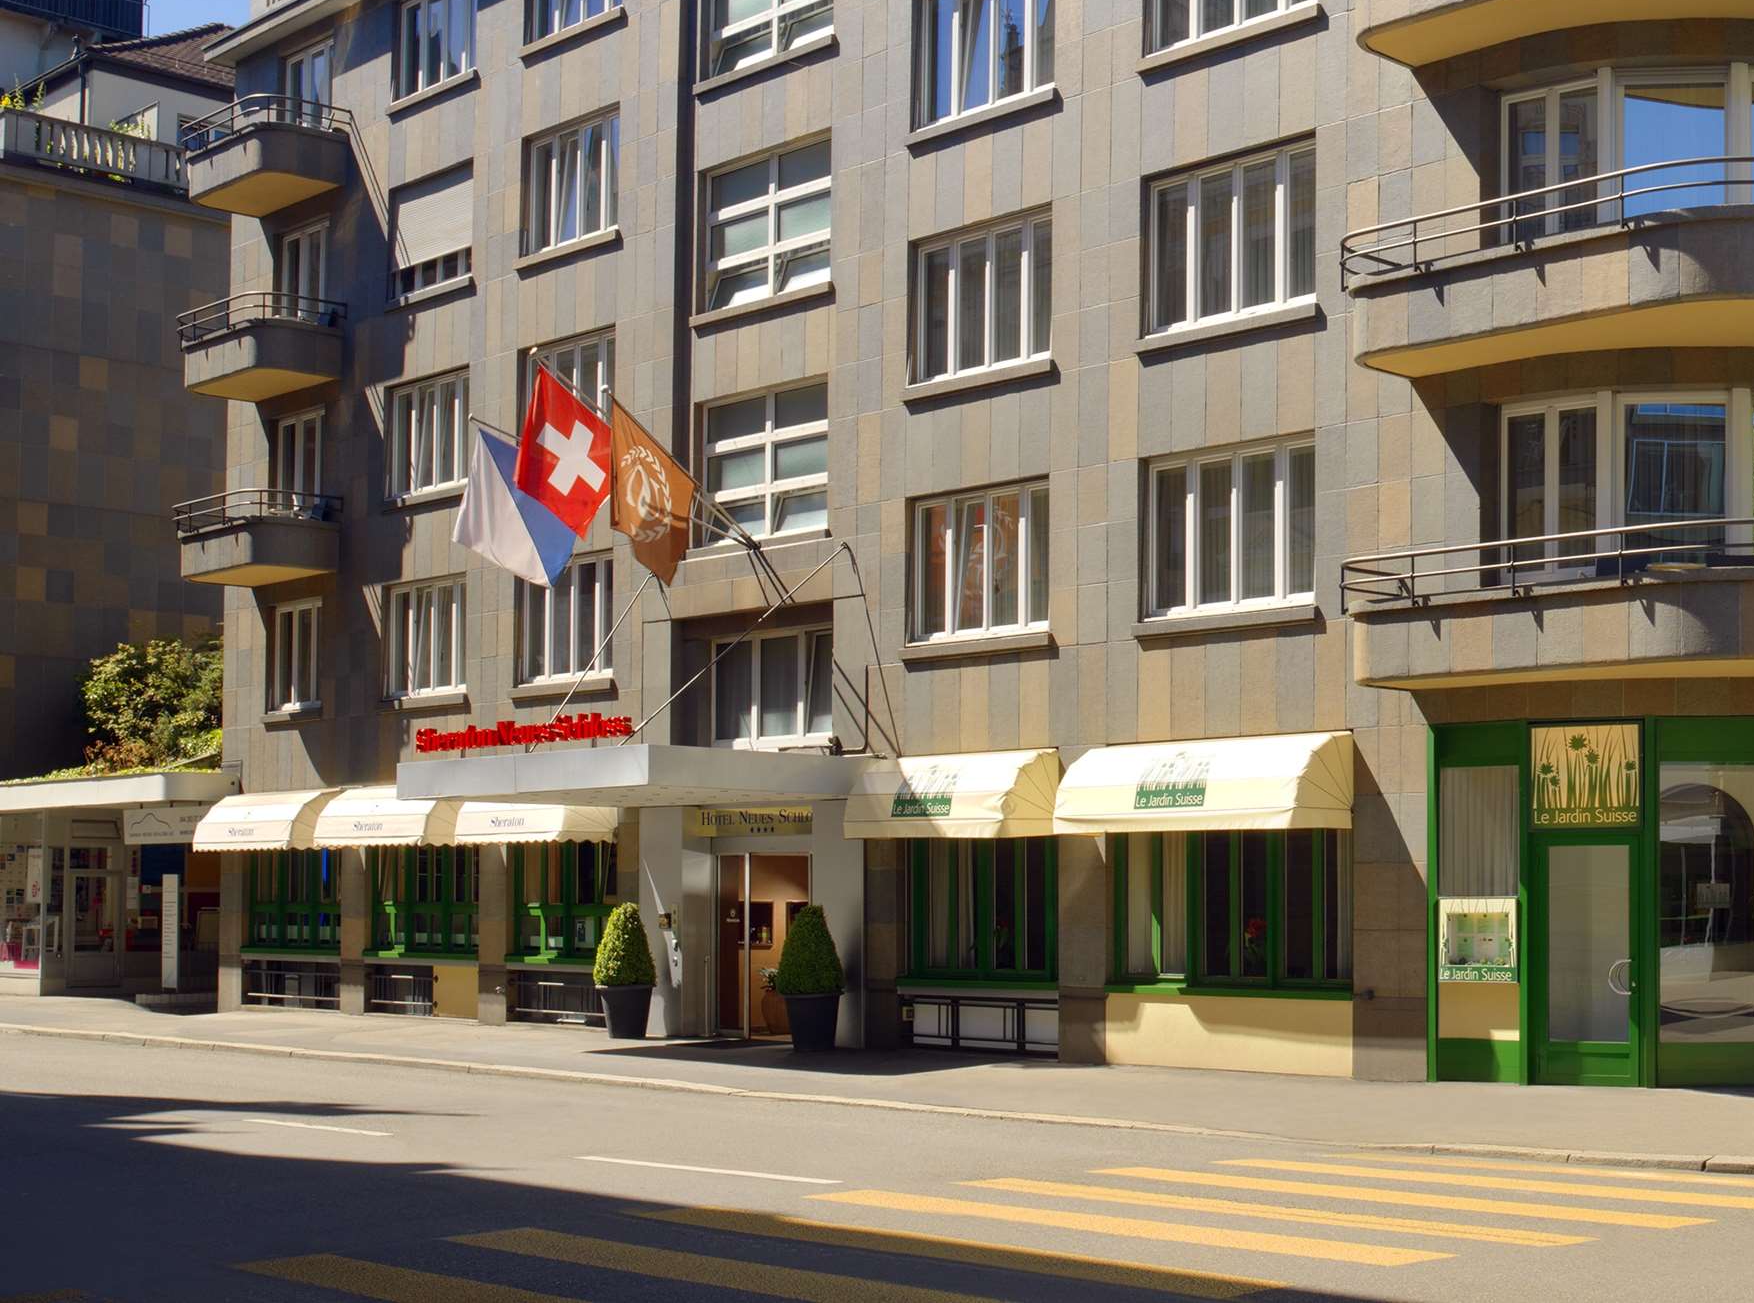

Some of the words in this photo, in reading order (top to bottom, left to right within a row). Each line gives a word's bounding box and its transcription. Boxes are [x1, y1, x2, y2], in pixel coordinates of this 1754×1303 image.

[1136, 794, 1146, 807] Le
[1148, 793, 1173, 807] Jardin
[1175, 792, 1203, 806] Suisse
[893, 802, 902, 814] Le
[903, 802, 925, 814] Jardin
[926, 802, 950, 814] Suisse
[1534, 810, 1550, 824] Le
[1553, 809, 1591, 824] Jardin
[1594, 808, 1637, 823] Suisse
[488, 817, 526, 829] Sheraton
[1440, 968, 1450, 980] Le
[1451, 968, 1479, 980] Jardin
[1481, 968, 1512, 981] Suisse
